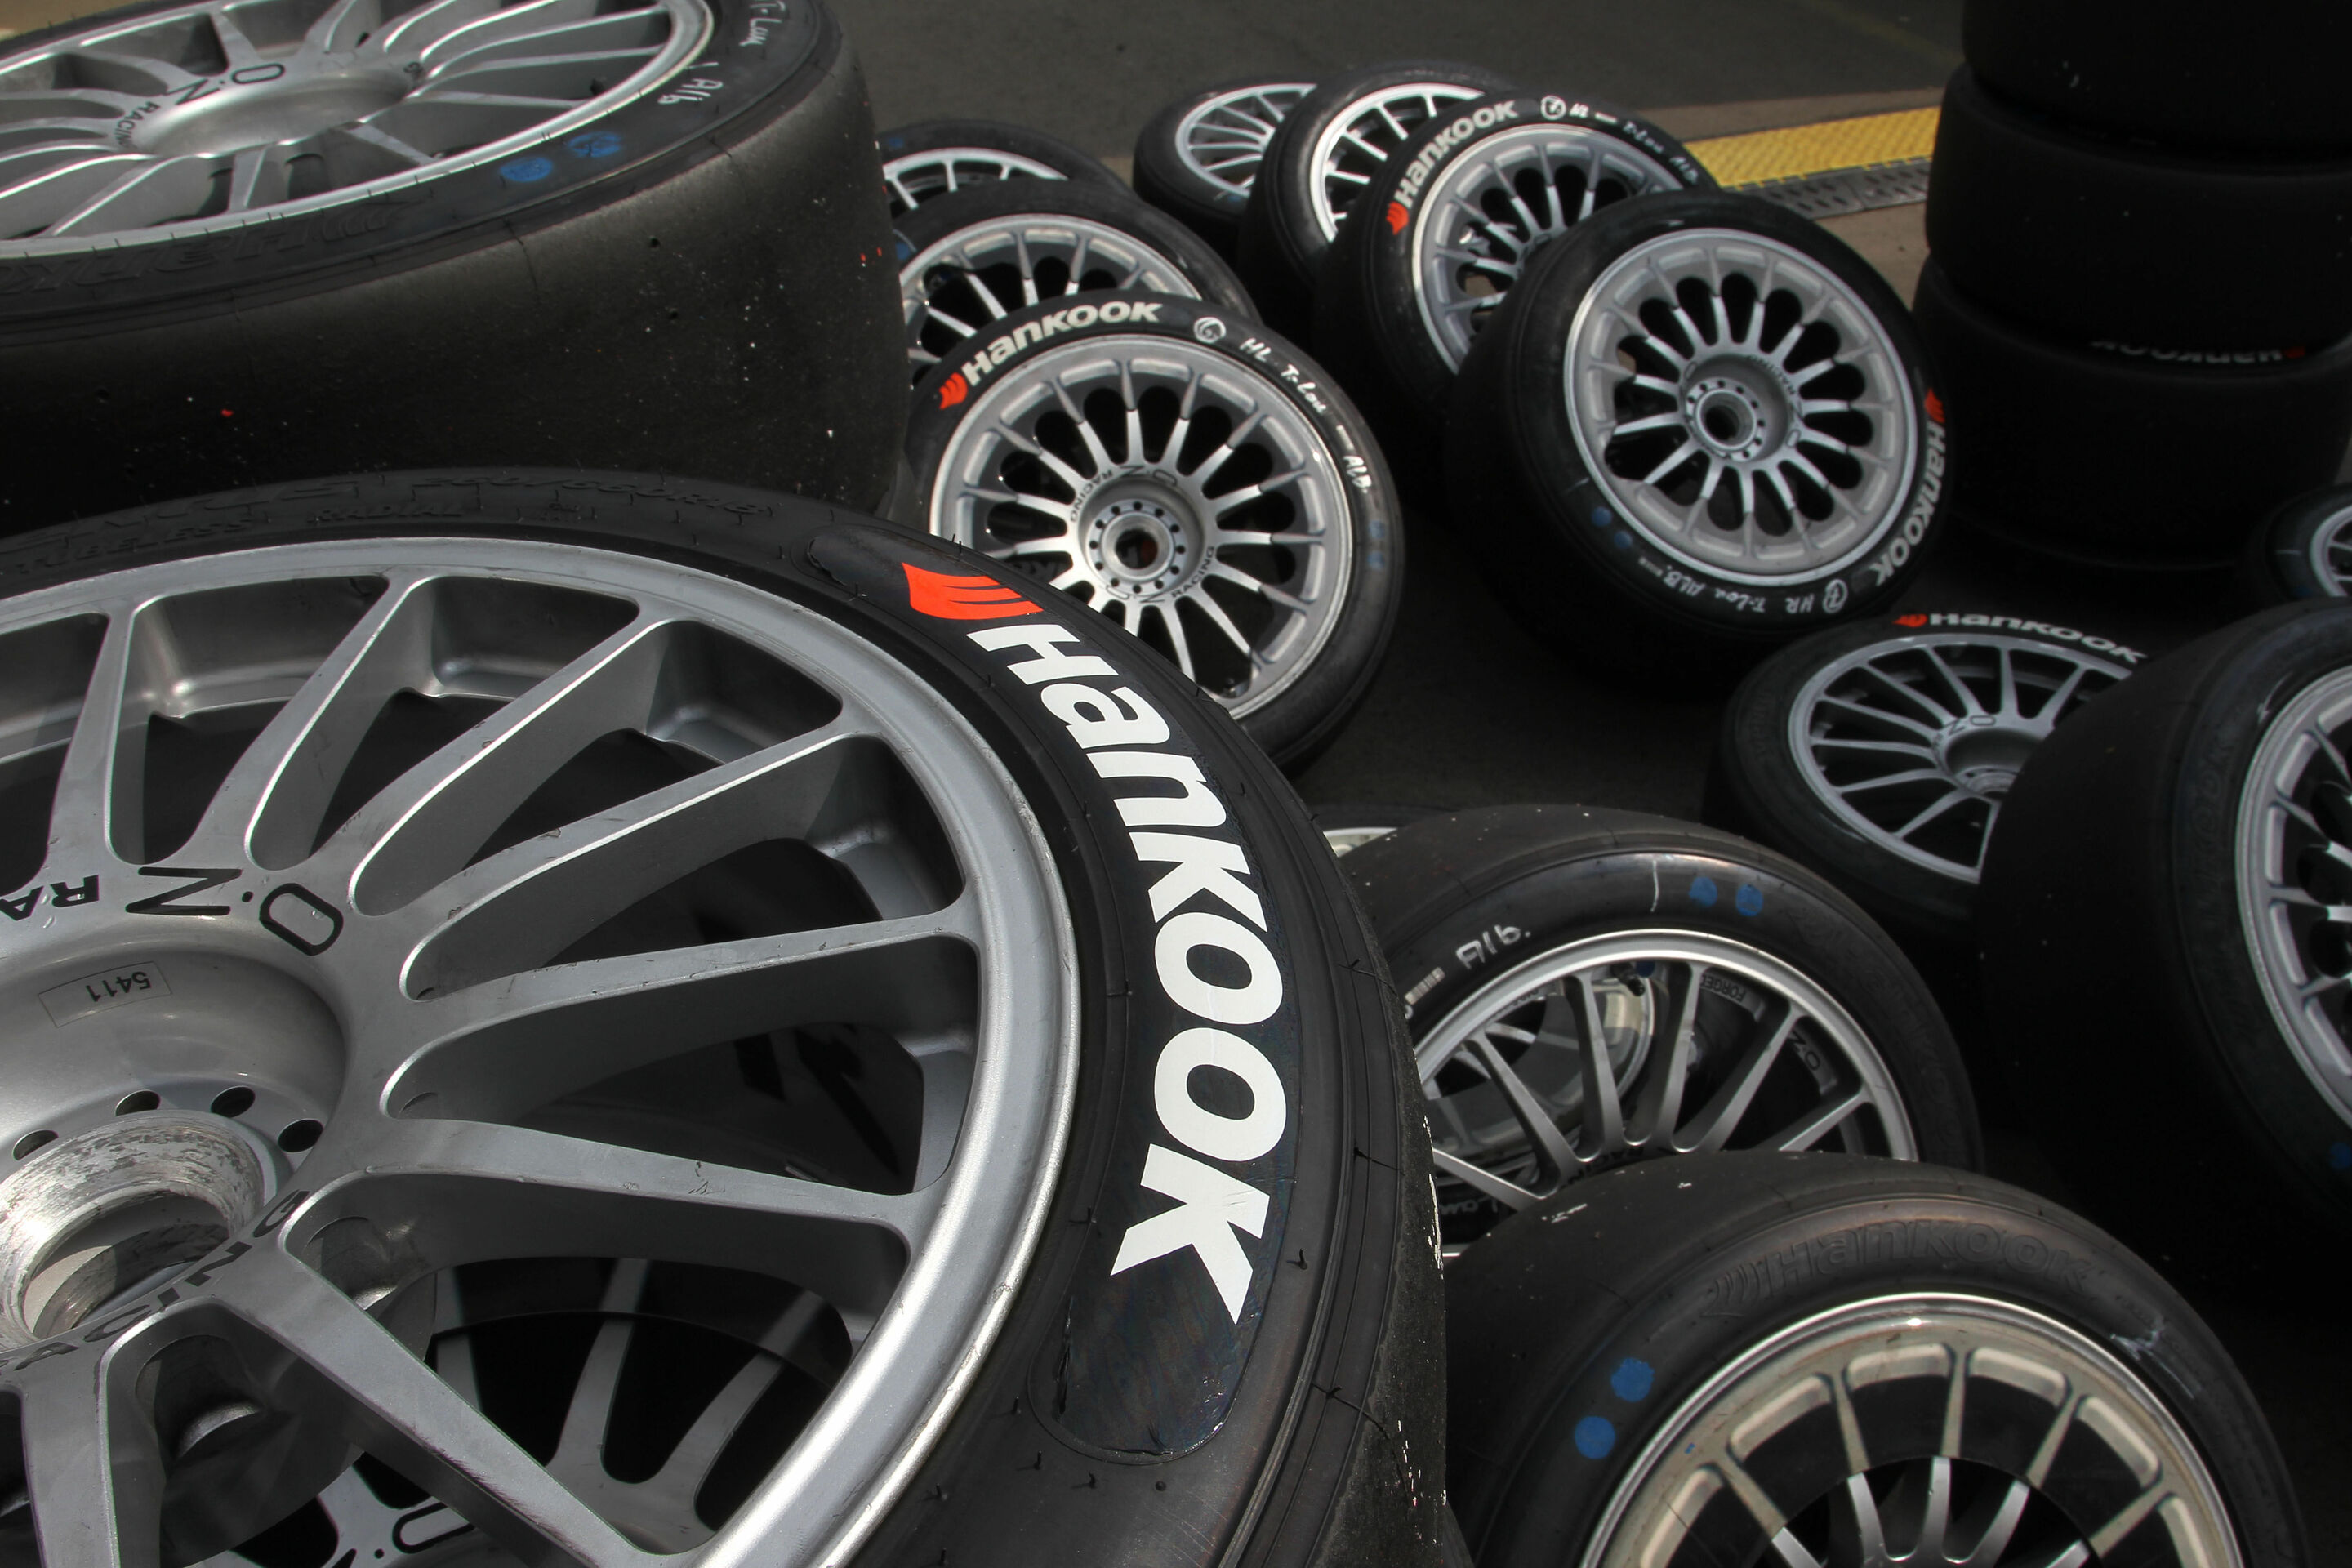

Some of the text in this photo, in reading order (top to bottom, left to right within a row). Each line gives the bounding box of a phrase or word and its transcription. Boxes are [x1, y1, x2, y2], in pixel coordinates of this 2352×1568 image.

[1239, 337, 1272, 362] HL
[86, 971, 152, 1002] 5411
[0, 1189, 310, 1377] ACING
